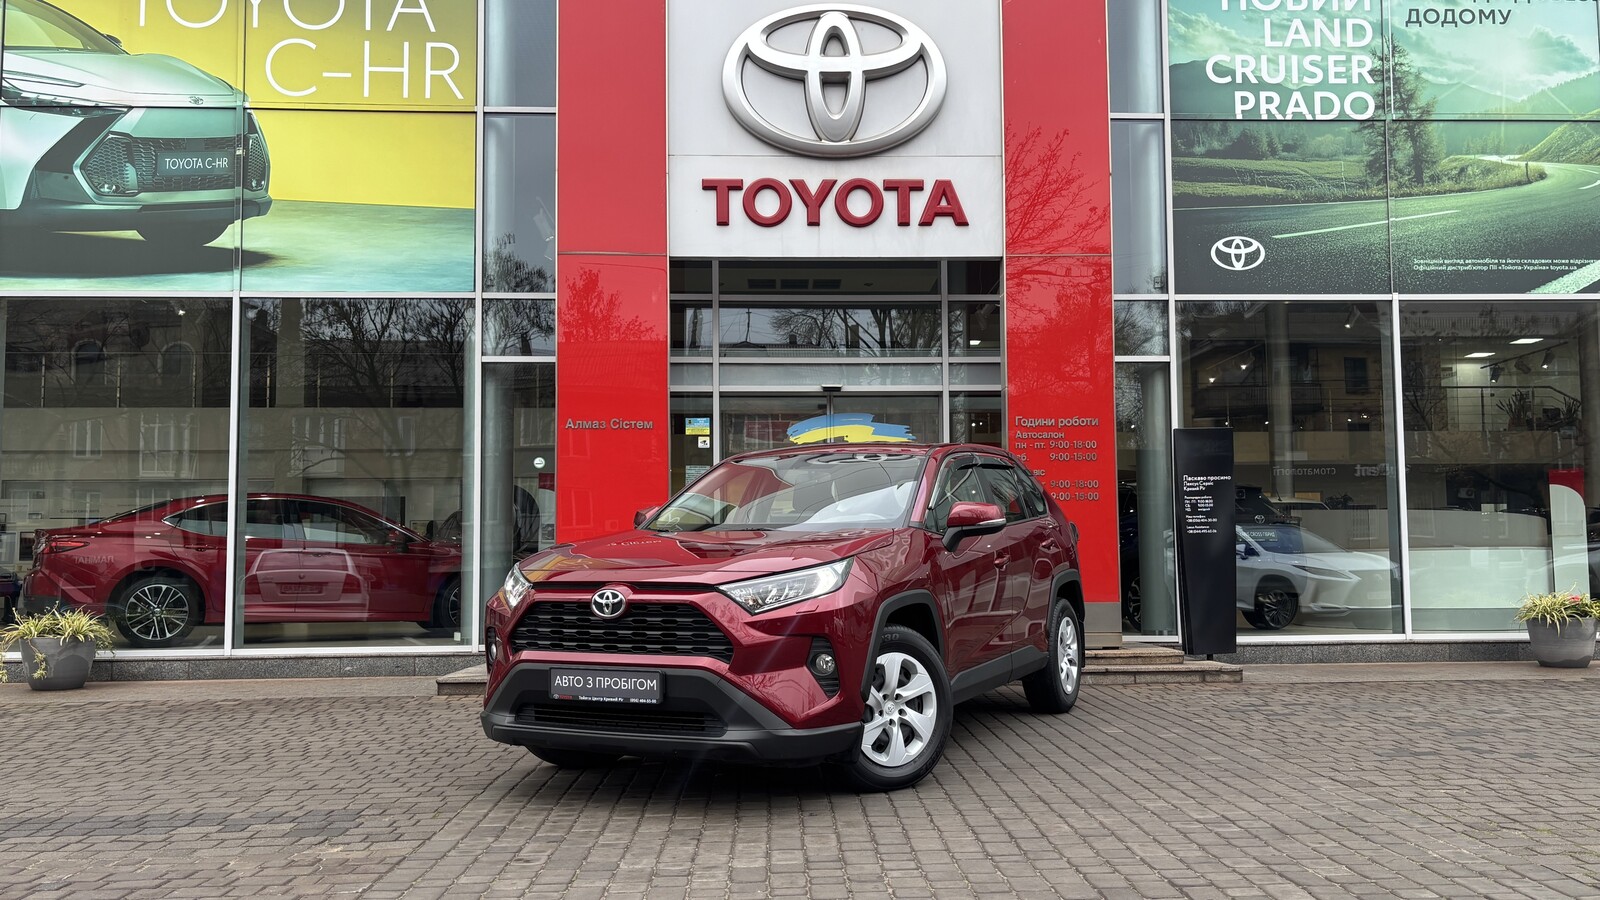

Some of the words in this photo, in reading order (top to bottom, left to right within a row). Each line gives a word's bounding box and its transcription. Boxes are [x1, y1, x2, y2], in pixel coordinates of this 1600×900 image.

[1405, 8, 1512, 27] ДОДОМУ
[1264, 18, 1374, 48] LAND
[265, 38, 464, 100] C-HR
[1206, 54, 1375, 84] CRUISER
[1234, 91, 1375, 120] PRADO
[164, 158, 204, 170] TOYOTA
[205, 157, 228, 168] C-HR
[702, 178, 969, 227] TOYOTA
[565, 418, 606, 430] Алмаз
[610, 418, 653, 430] Сістем
[1015, 416, 1055, 428] Години
[1058, 416, 1099, 428] роботи
[1015, 430, 1064, 439] Автосалон
[554, 676, 583, 687] АВТО
[596, 677, 657, 690] ПРОБІГОМ
